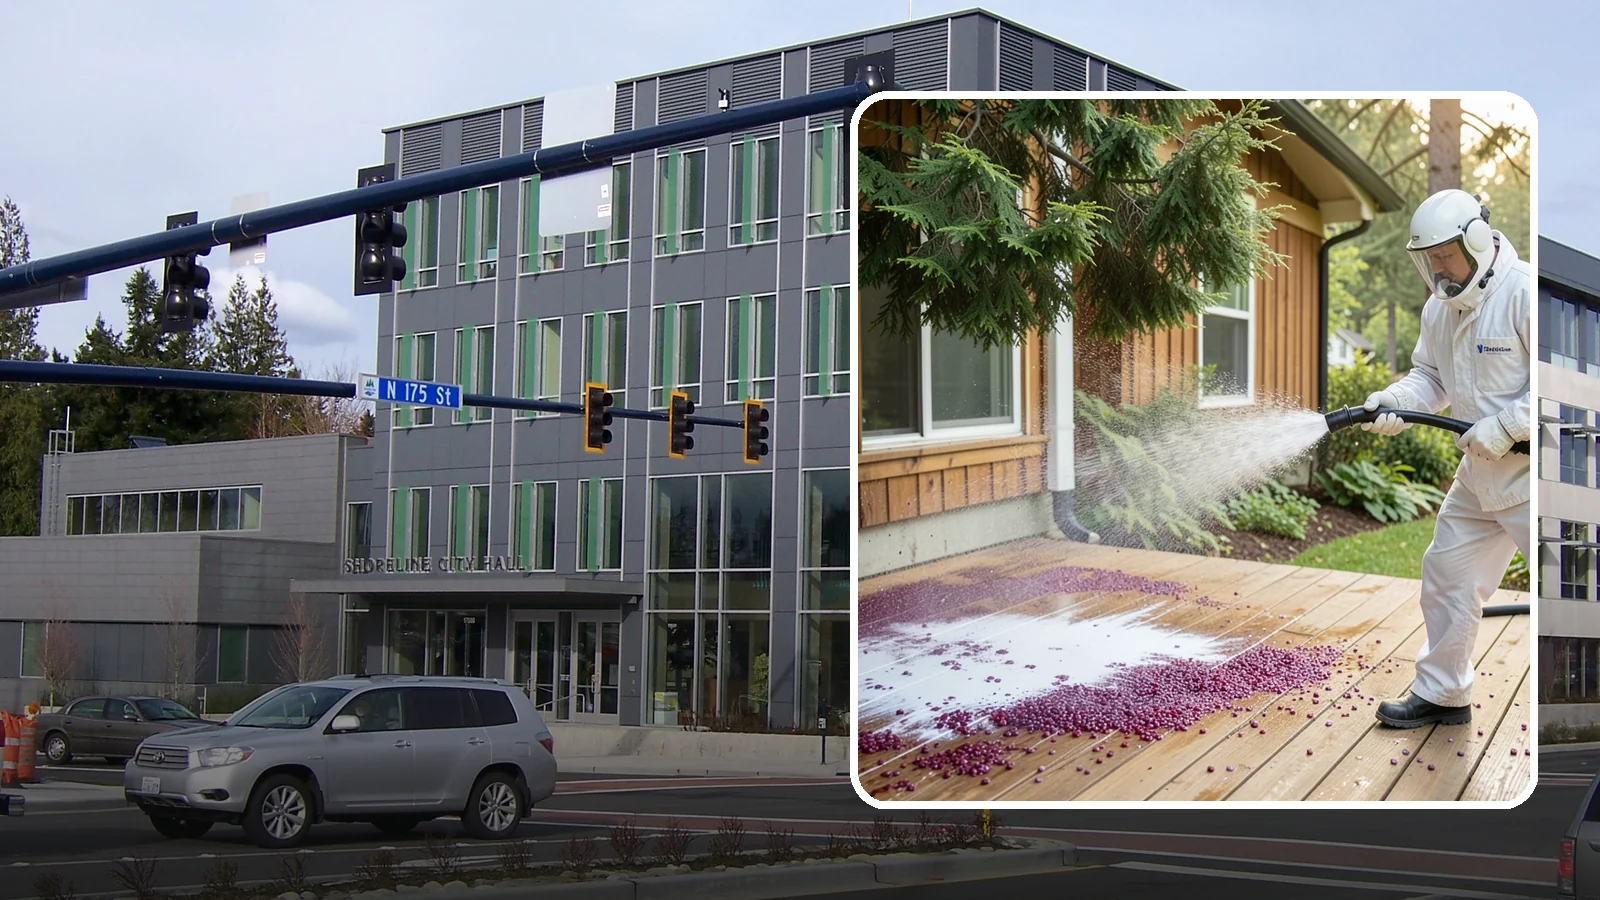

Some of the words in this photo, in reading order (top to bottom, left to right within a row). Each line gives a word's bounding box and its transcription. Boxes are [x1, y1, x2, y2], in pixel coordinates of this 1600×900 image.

[387, 380, 396, 400] N
[405, 382, 428, 403] 175
[436, 386, 451, 406] St
[344, 556, 433, 574] SHORELINE
[438, 556, 476, 572] CITY
[484, 555, 526, 571] HALL
